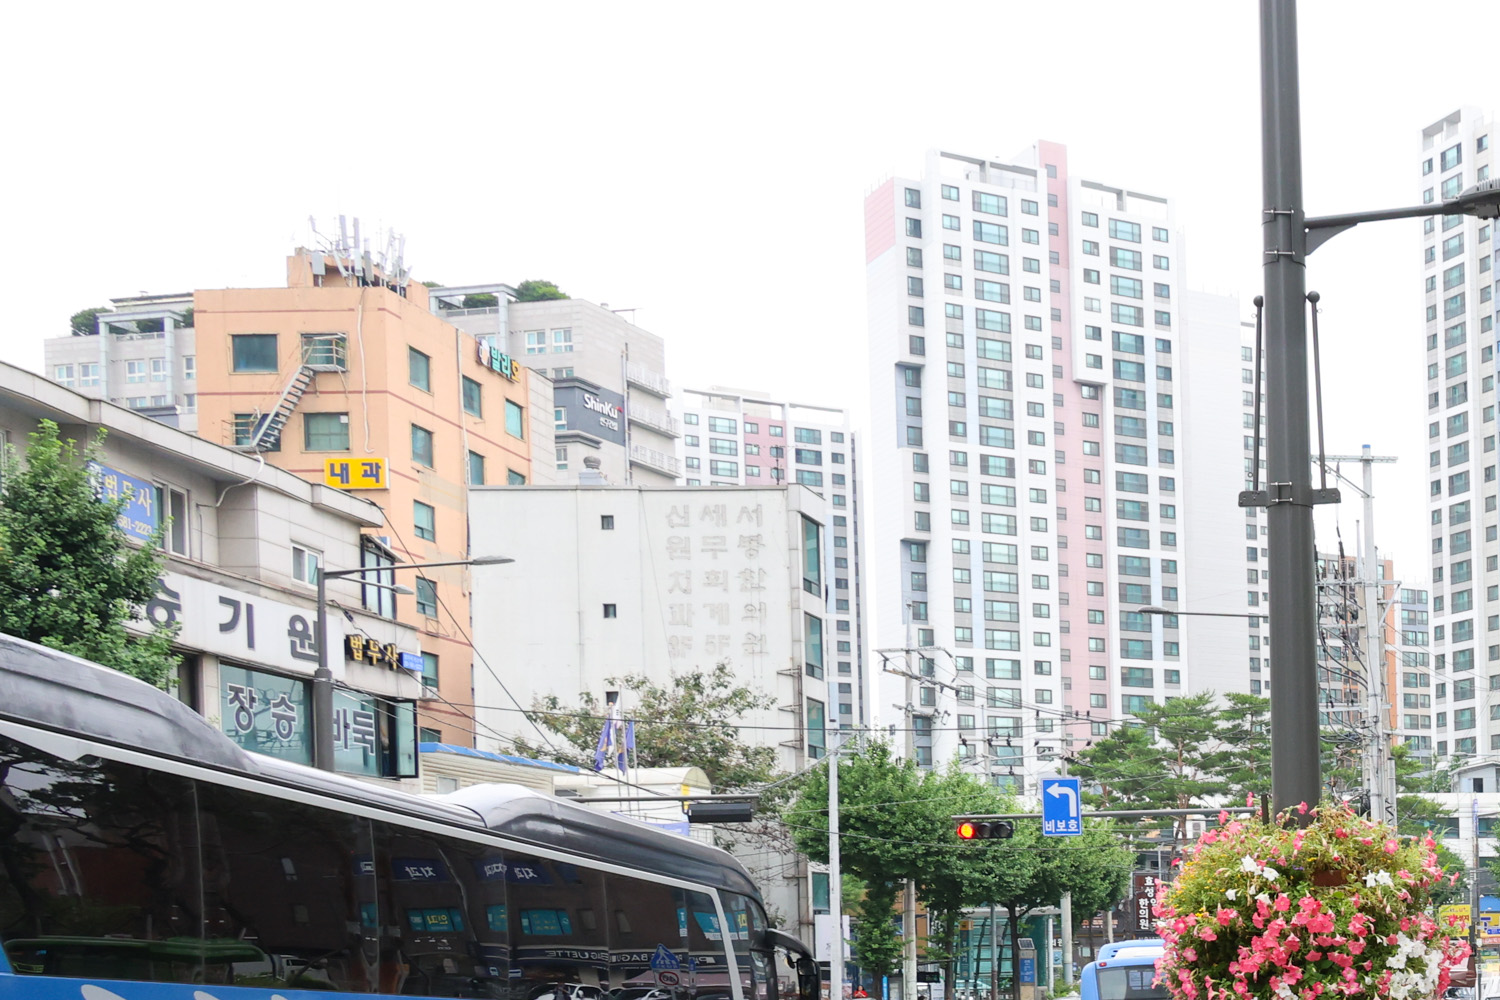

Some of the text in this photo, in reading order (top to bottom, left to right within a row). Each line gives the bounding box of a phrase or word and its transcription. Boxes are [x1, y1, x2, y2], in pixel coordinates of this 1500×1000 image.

[583, 393, 618, 419] ShinKu
[330, 462, 381, 485] 내과
[104, 474, 152, 517] 법무사
[350, 634, 399, 670] 법무사
[227, 683, 297, 742] 장승
[1045, 819, 1079, 833] 비보호
[1144, 876, 1155, 897] 효성
[1139, 898, 1150, 930] 한의원
